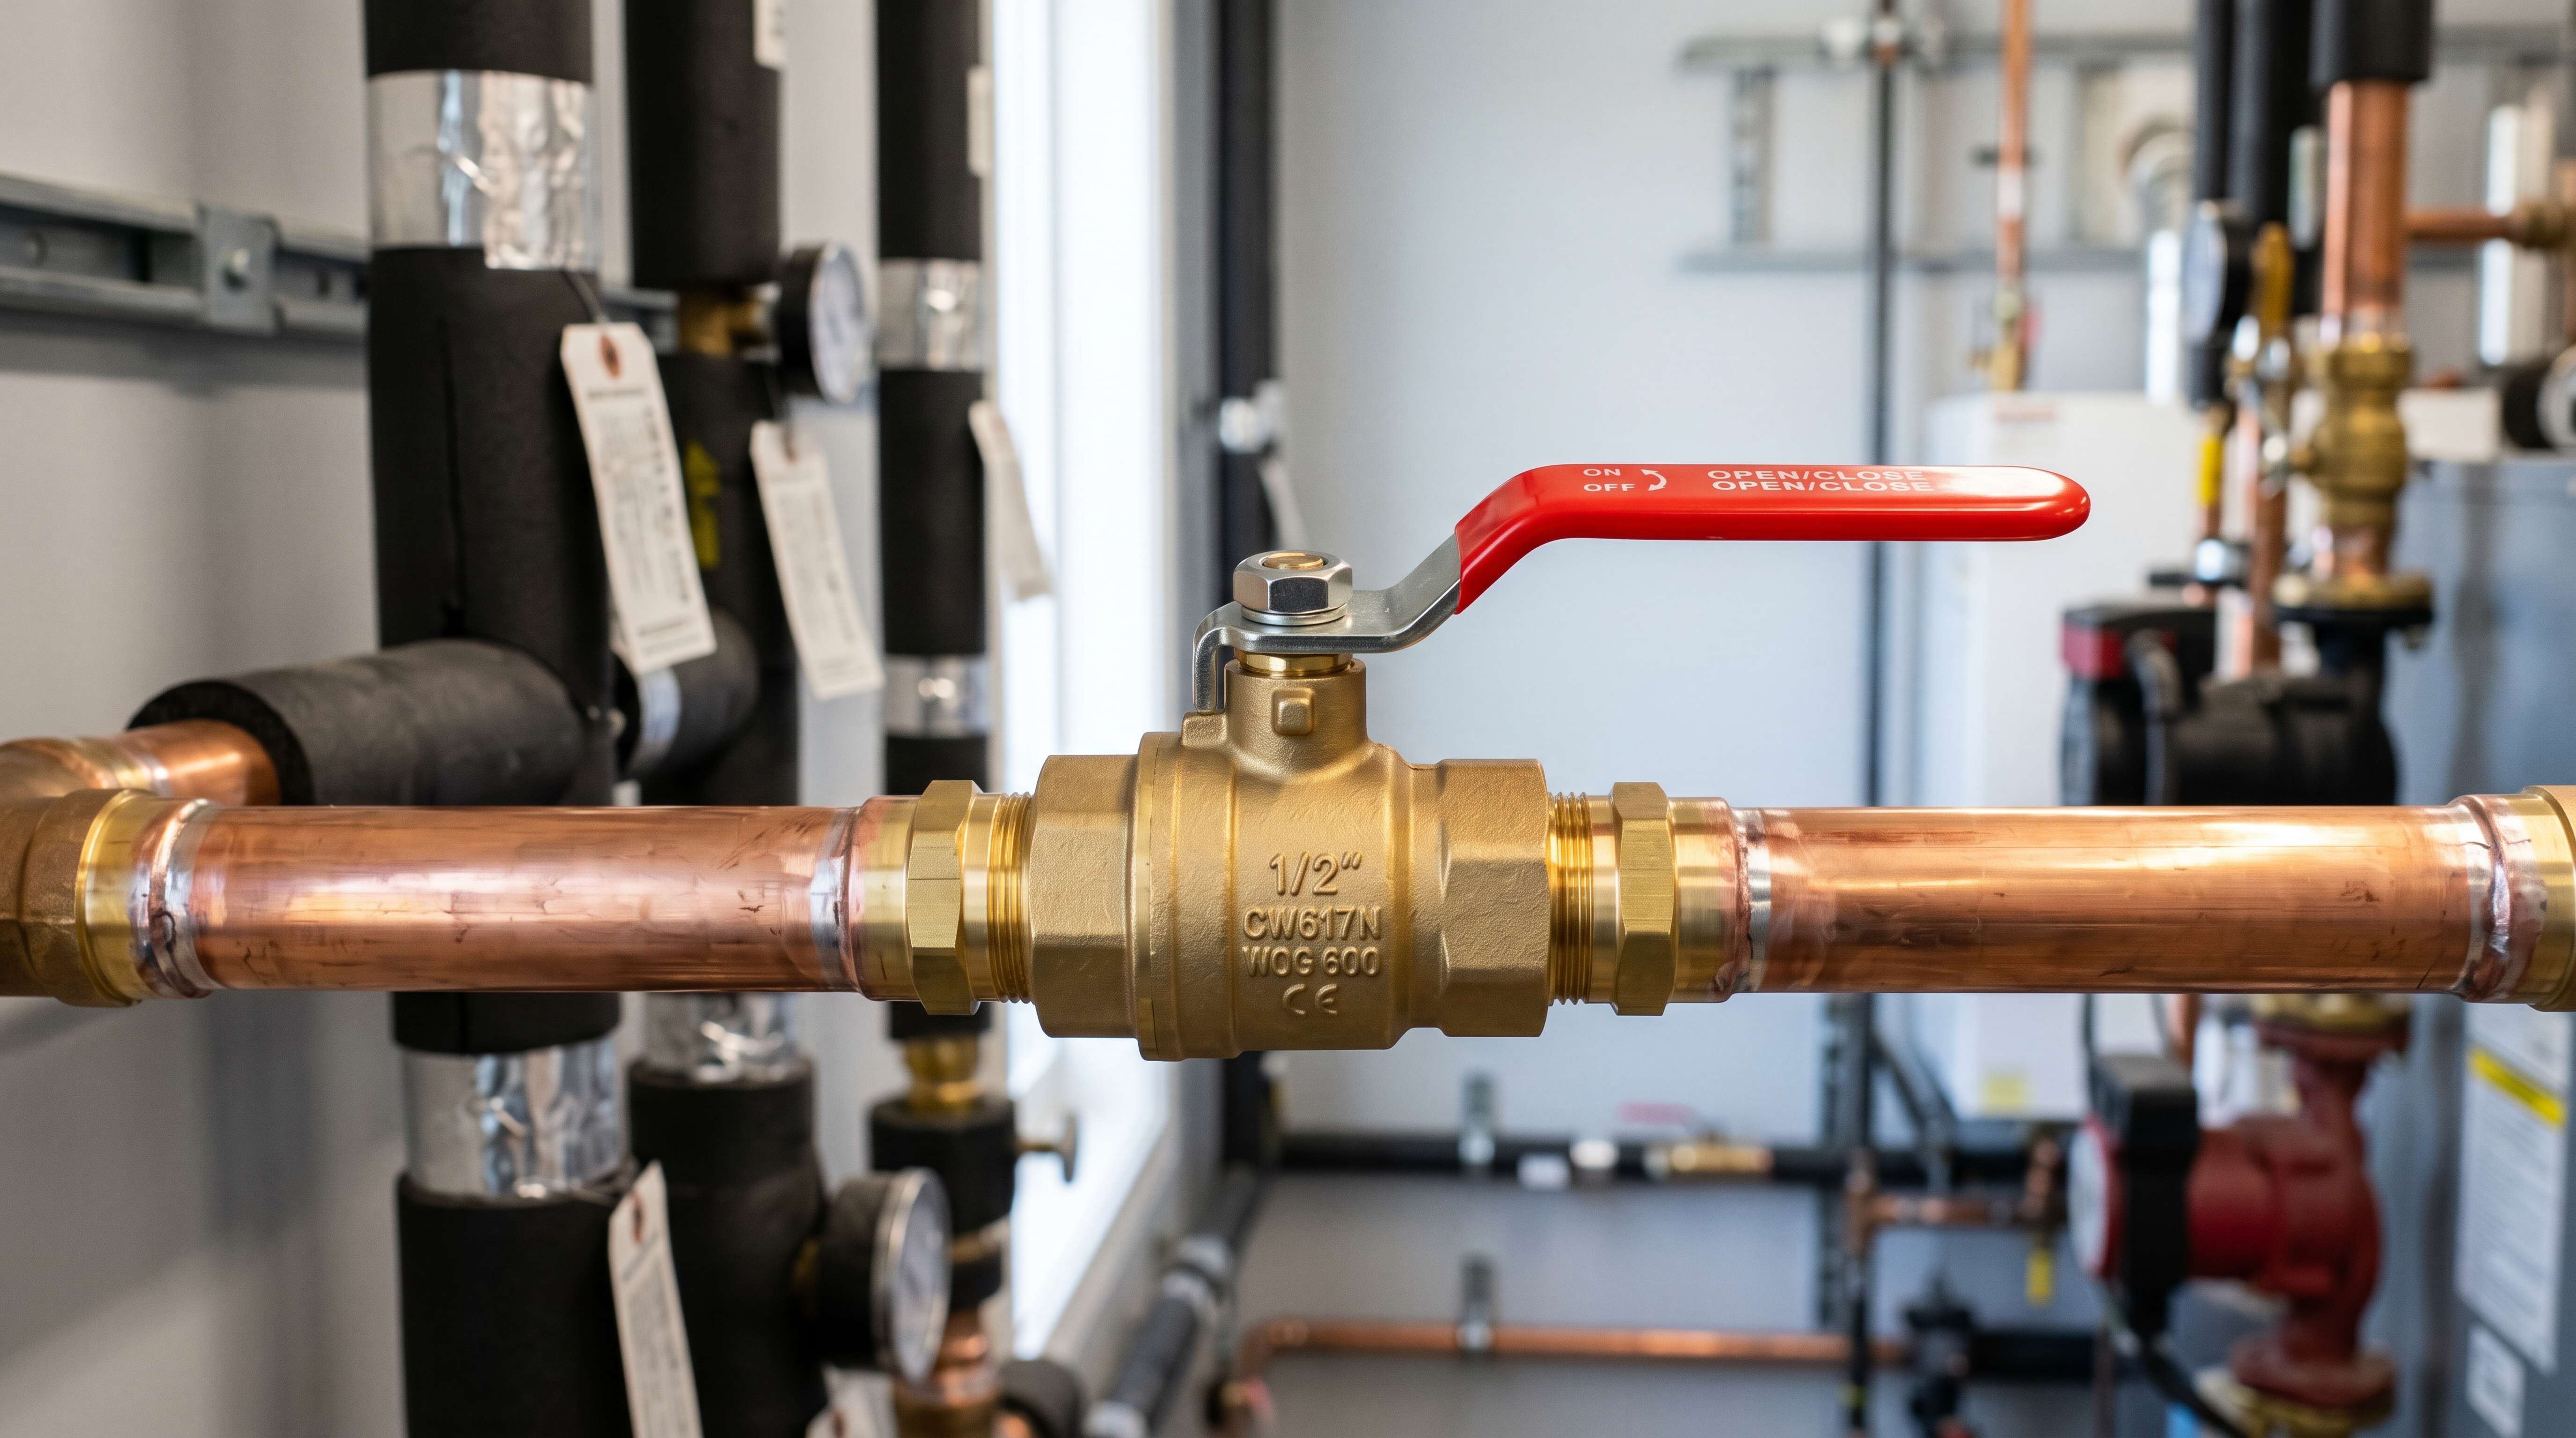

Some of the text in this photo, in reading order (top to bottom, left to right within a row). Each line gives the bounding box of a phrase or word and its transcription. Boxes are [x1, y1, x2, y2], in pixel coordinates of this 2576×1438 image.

[1707, 470, 1927, 480] OPEN/CLOSE
[1712, 481, 1934, 491] OPEN/CLOSE
[1269, 851, 1362, 896] 1/2"
[1243, 906, 1382, 940] CW617N
[1242, 946, 1381, 977] WOG 600
[1282, 983, 1338, 1015] CE
